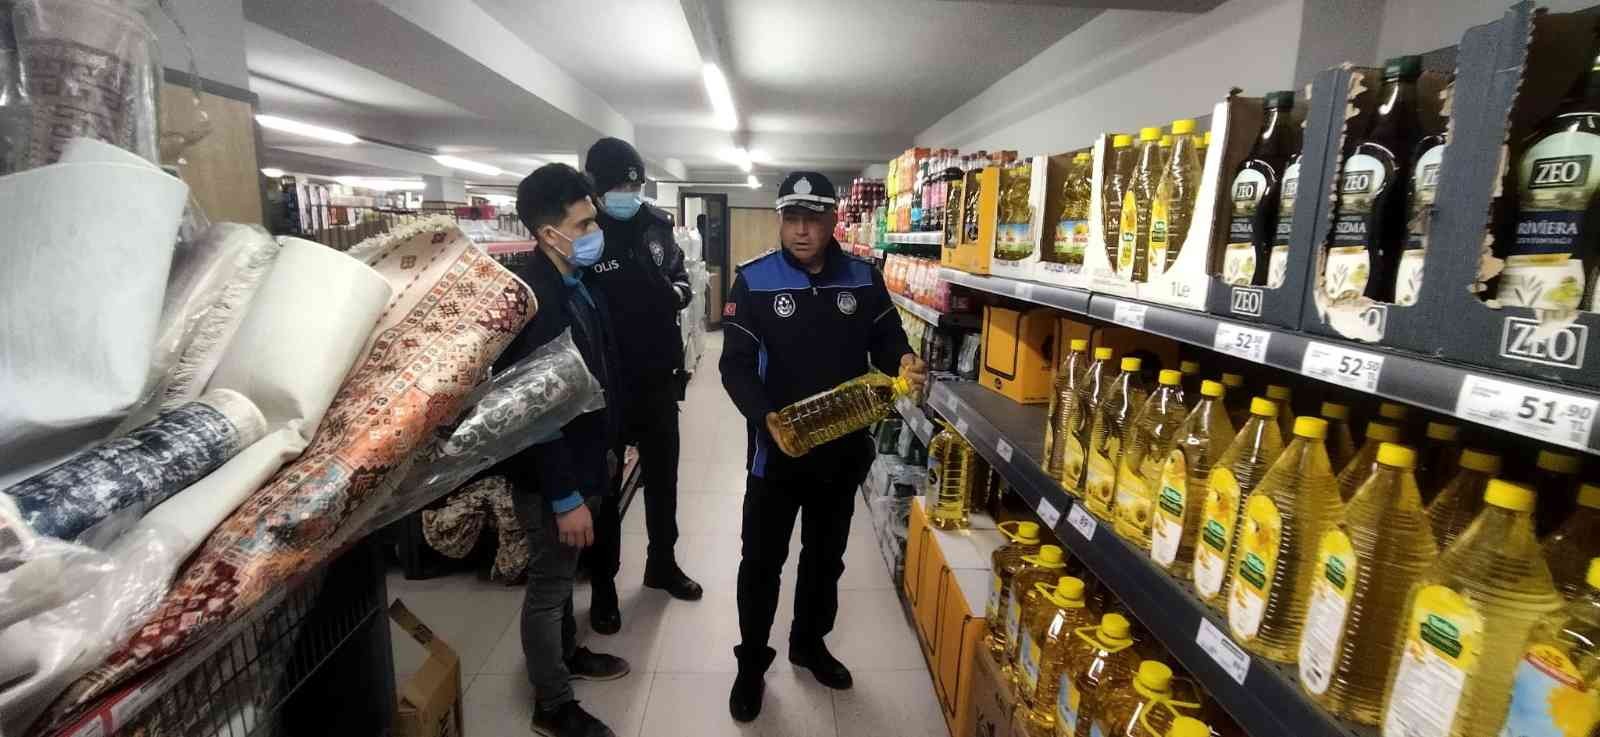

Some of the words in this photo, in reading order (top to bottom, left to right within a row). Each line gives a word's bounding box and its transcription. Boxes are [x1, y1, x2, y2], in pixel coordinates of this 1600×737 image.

[1423, 168, 1440, 185] ZE
[1534, 161, 1581, 184] ZEO
[1343, 174, 1369, 191] ZEO
[1237, 185, 1254, 199] ZEO
[1335, 222, 1367, 234] SIZMA
[594, 259, 620, 273] OLİS
[1234, 290, 1259, 313] ZEO
[1508, 323, 1577, 361] ZEO
